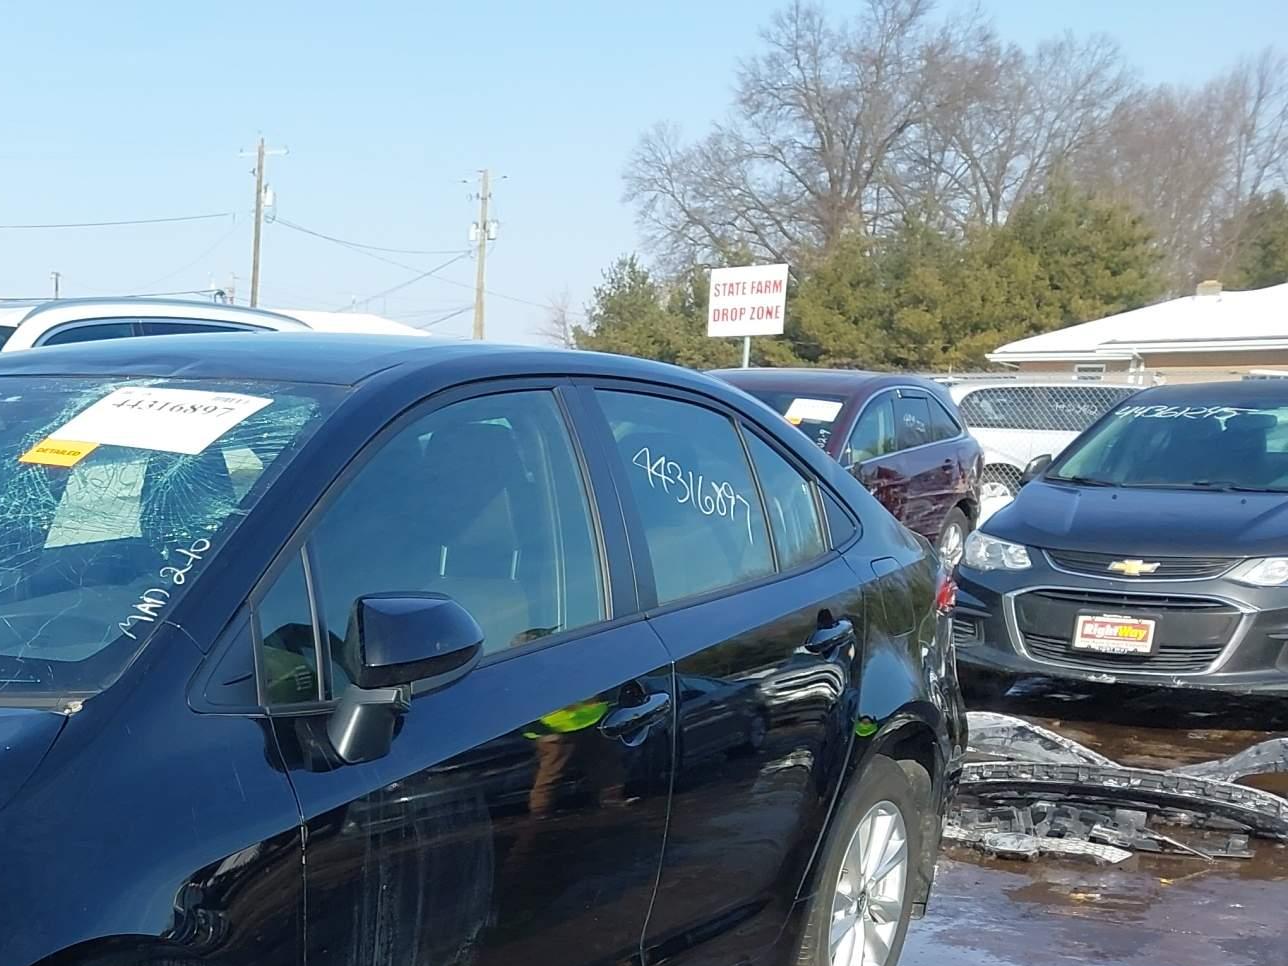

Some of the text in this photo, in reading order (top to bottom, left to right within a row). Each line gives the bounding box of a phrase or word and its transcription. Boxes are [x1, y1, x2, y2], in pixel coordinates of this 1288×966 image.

[713, 279, 783, 297] STATE FARM
[712, 305, 781, 323] DROP ZONE
[112, 399, 235, 418] 44316897
[35, 447, 81, 458] DETAILED
[632, 447, 754, 545] 44316897
